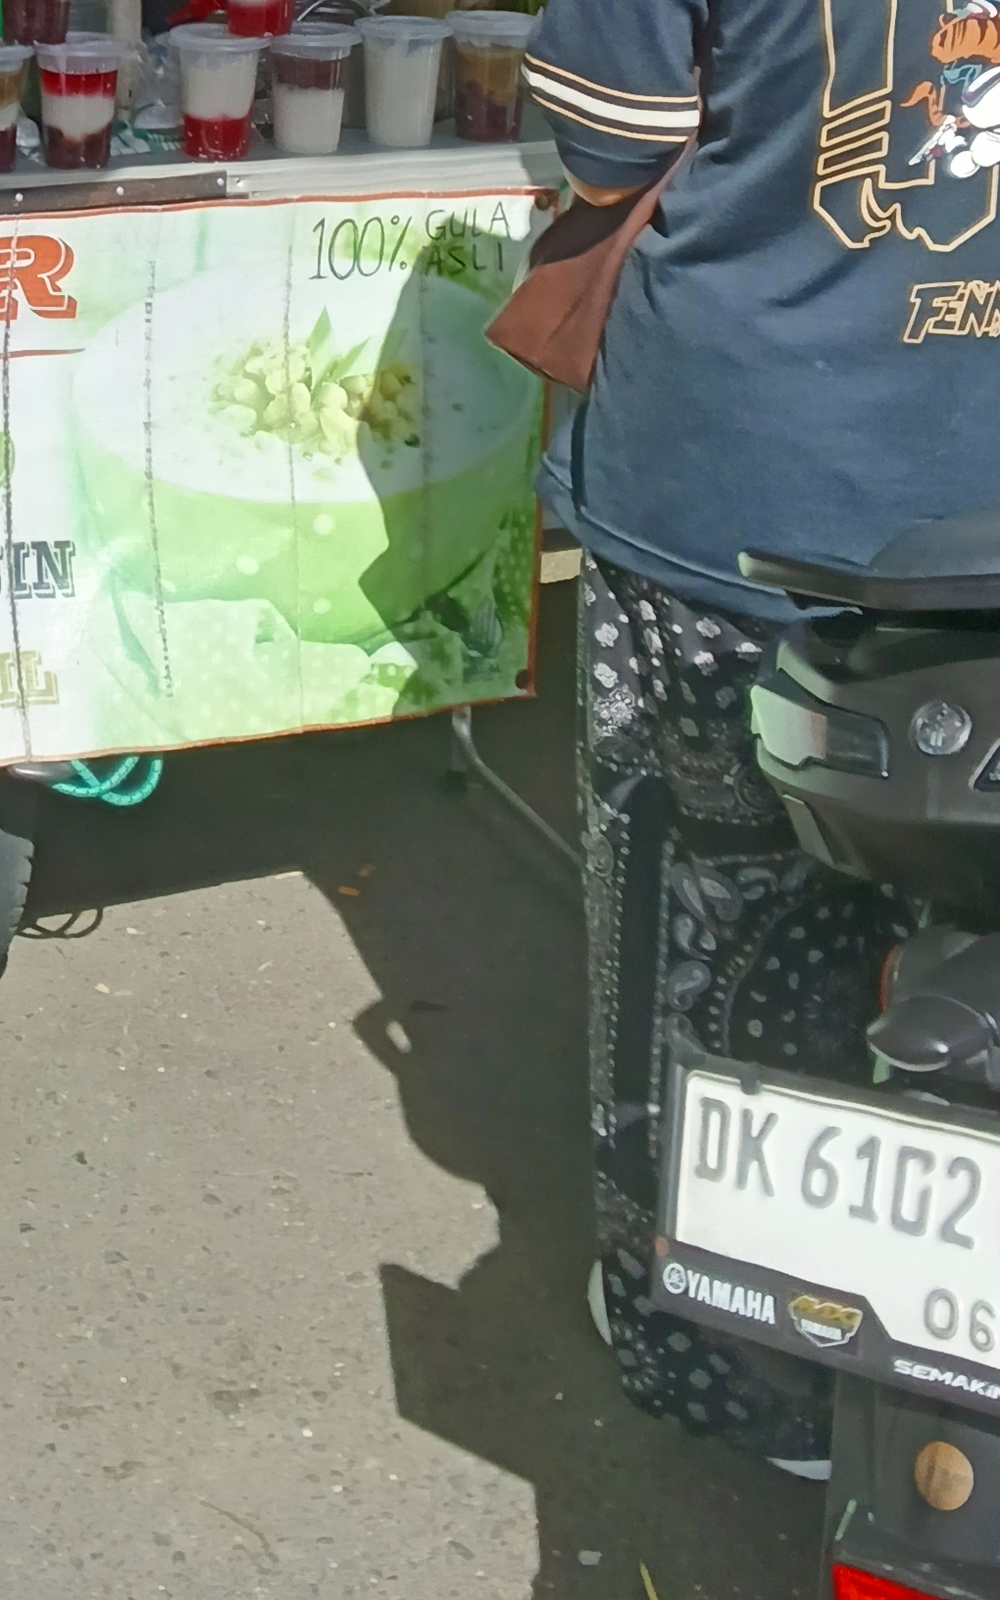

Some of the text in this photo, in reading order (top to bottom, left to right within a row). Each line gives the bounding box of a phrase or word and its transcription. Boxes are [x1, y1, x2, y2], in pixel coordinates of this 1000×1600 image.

[309, 200, 512, 281] 100% GULA
[424, 242, 504, 277] ASLI
[695, 1096, 982, 1251] DK 6102
[686, 1269, 776, 1325] YAMAHA
